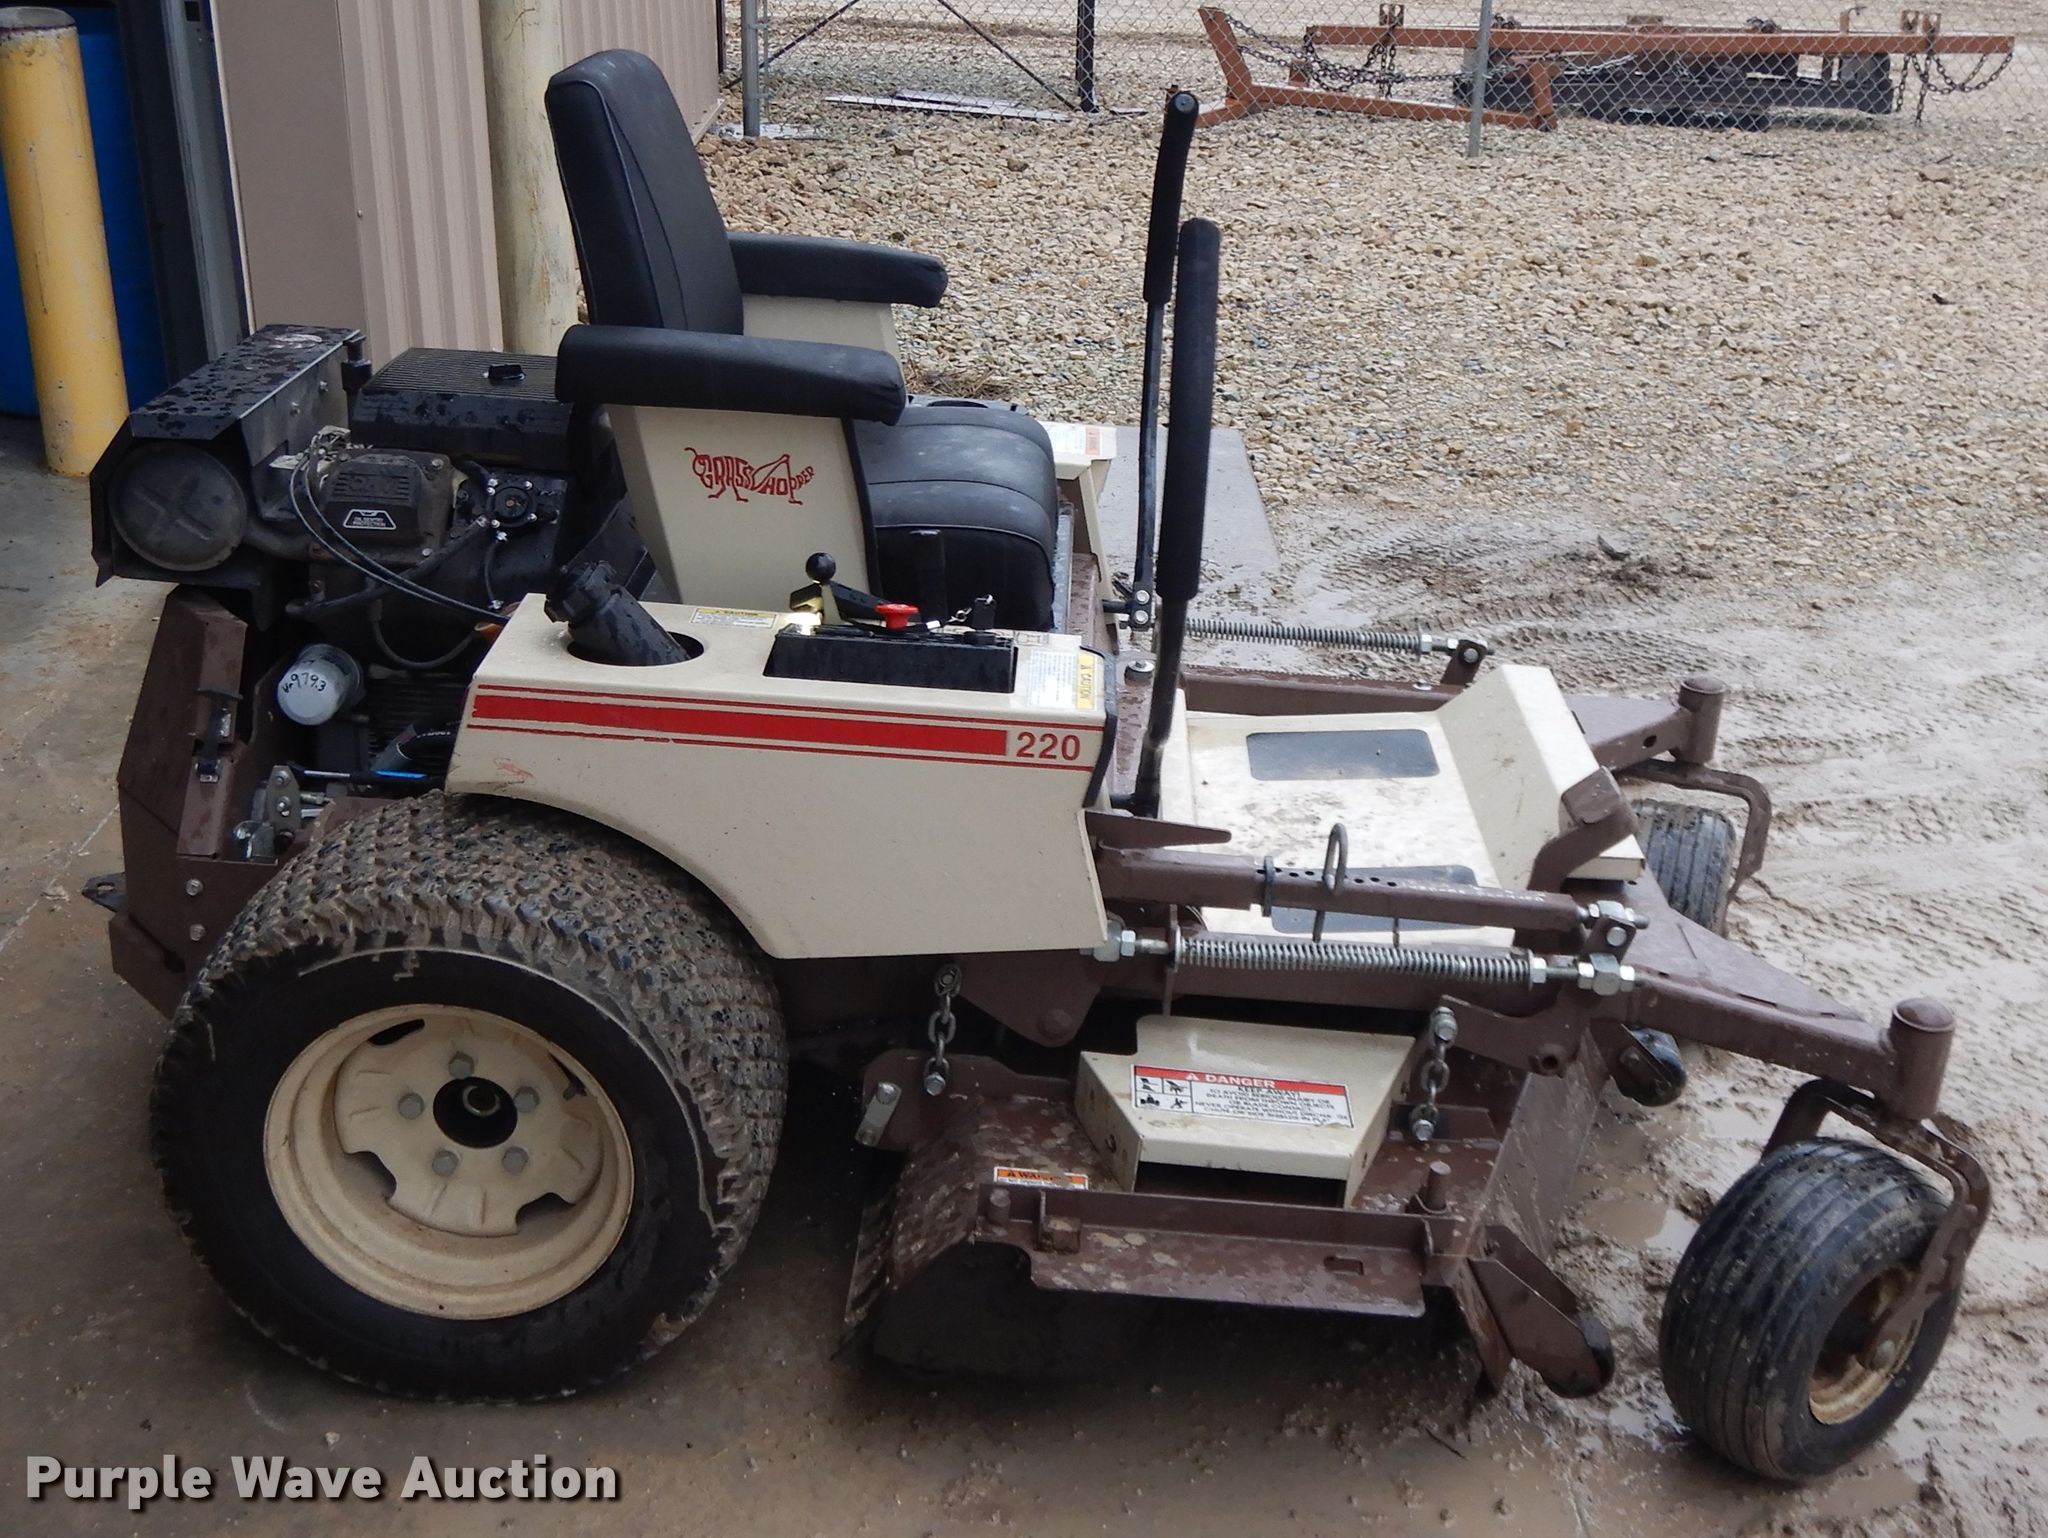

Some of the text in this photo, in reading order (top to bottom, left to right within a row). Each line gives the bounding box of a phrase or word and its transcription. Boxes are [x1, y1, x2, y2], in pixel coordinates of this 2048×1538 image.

[688, 450, 815, 504] GRASSHOPPER
[1080, 673, 1092, 699] CAUTION
[1016, 731, 1081, 761] 220
[1205, 1074, 1276, 1088] DANGER
[1237, 1085, 1262, 1093] KEEP
